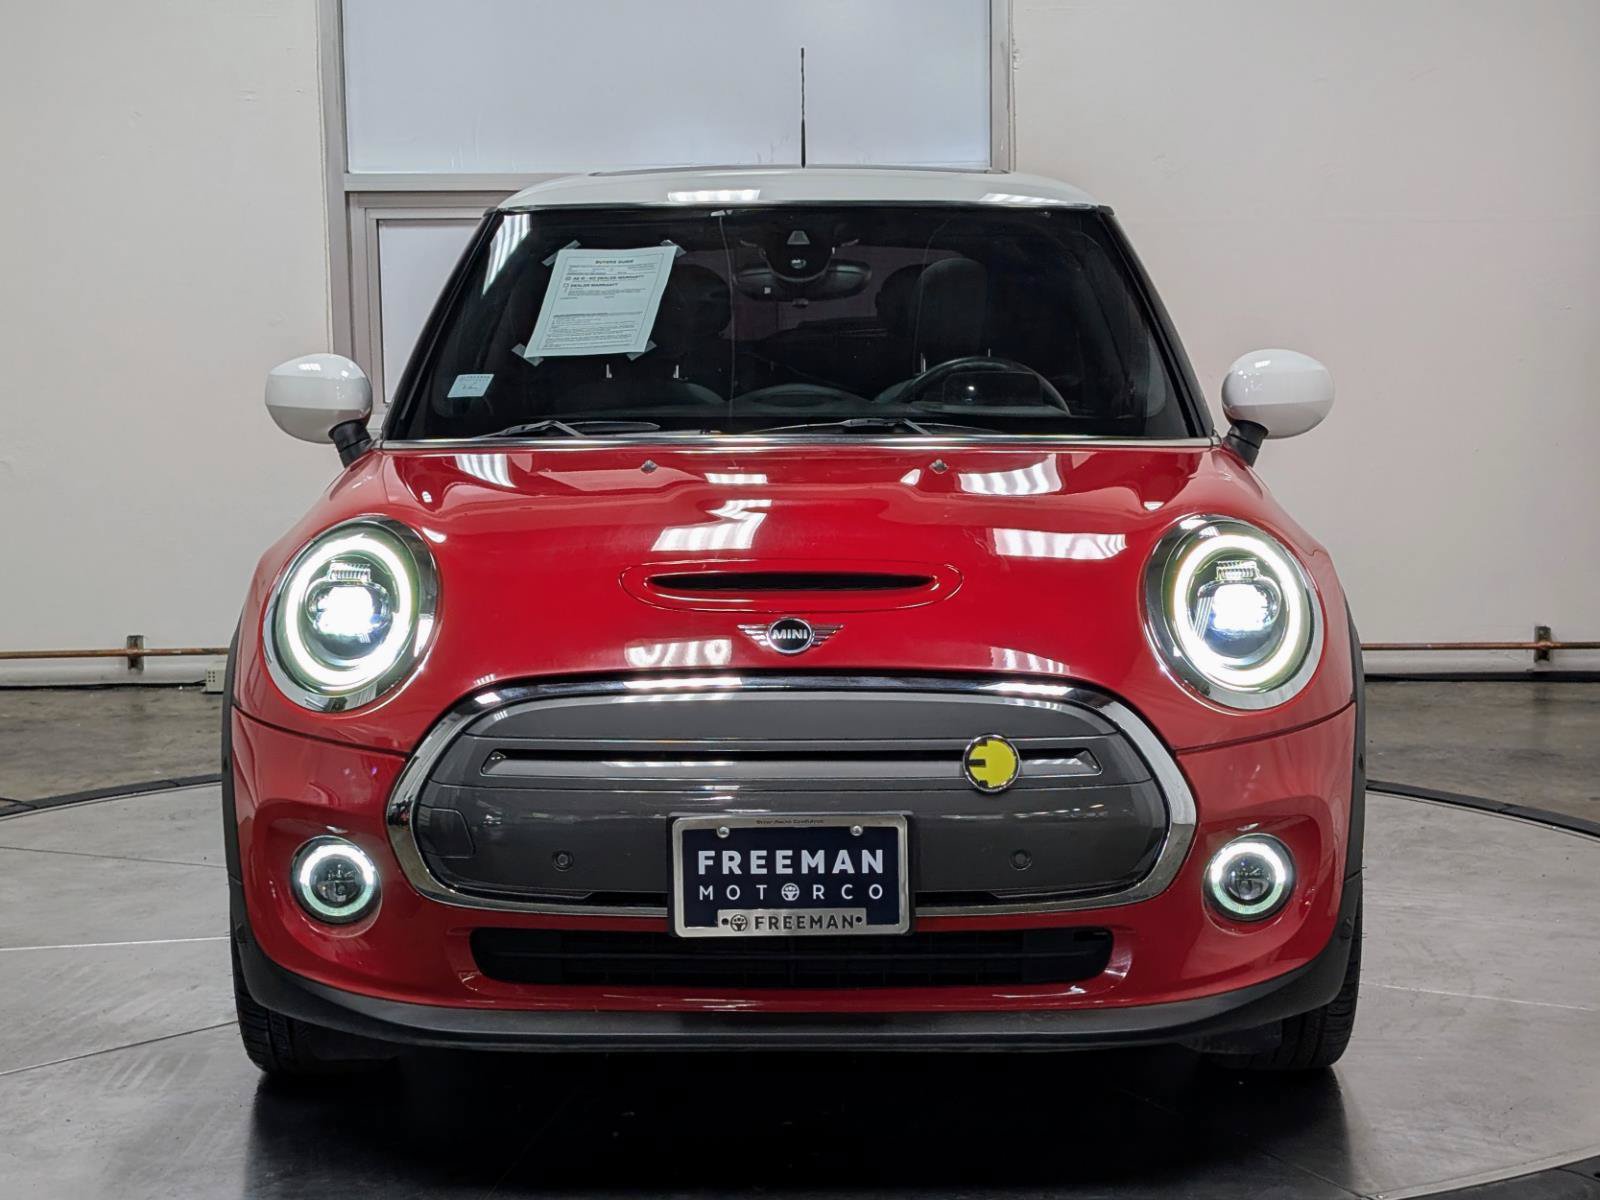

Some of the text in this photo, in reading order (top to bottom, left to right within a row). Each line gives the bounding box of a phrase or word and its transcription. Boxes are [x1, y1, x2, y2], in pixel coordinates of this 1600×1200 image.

[772, 629, 808, 640] MINI
[697, 849, 884, 875] FREEMAN
[754, 914, 854, 931] FREEMAN
